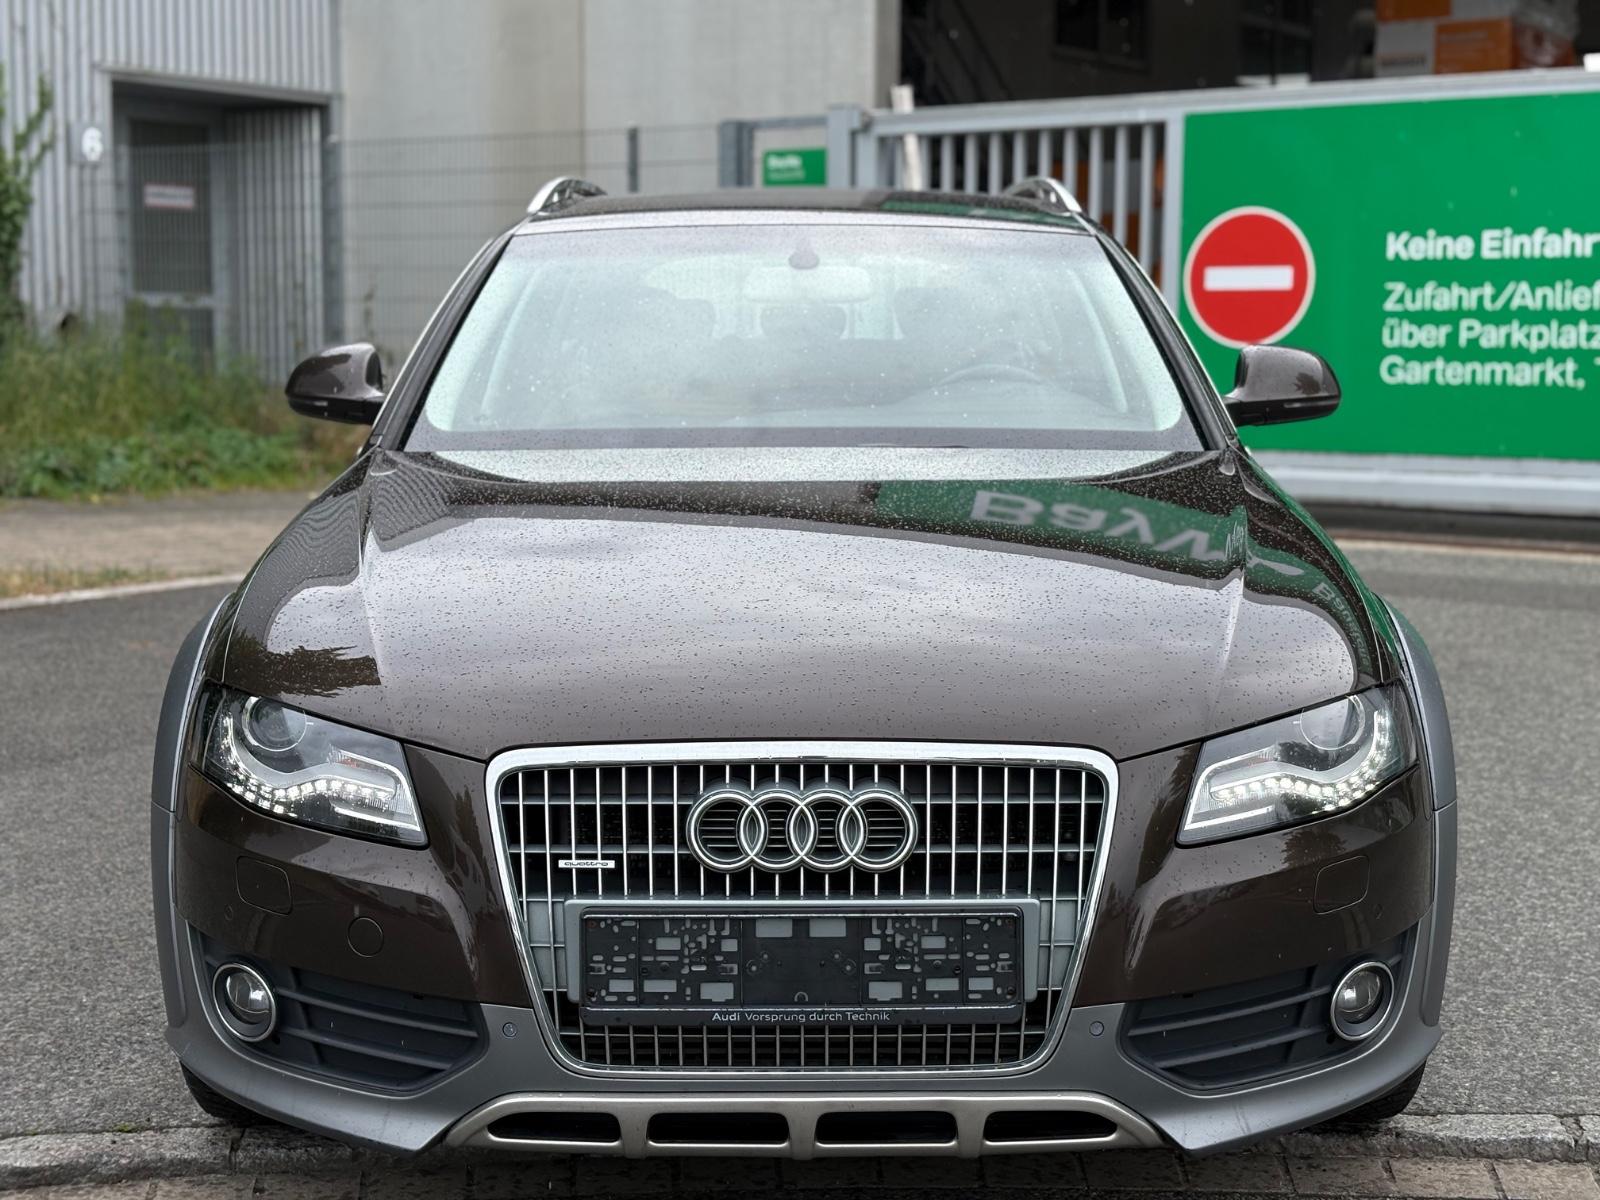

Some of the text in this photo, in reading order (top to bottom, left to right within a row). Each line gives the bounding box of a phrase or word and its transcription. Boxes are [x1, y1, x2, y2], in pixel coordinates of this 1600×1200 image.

[1386, 228, 1476, 261] Keine
[1382, 316, 1453, 349] über
[1379, 354, 1586, 390] Gartenmarkt,
[711, 1011, 890, 1023] Audi Vorsprung durch Technik
